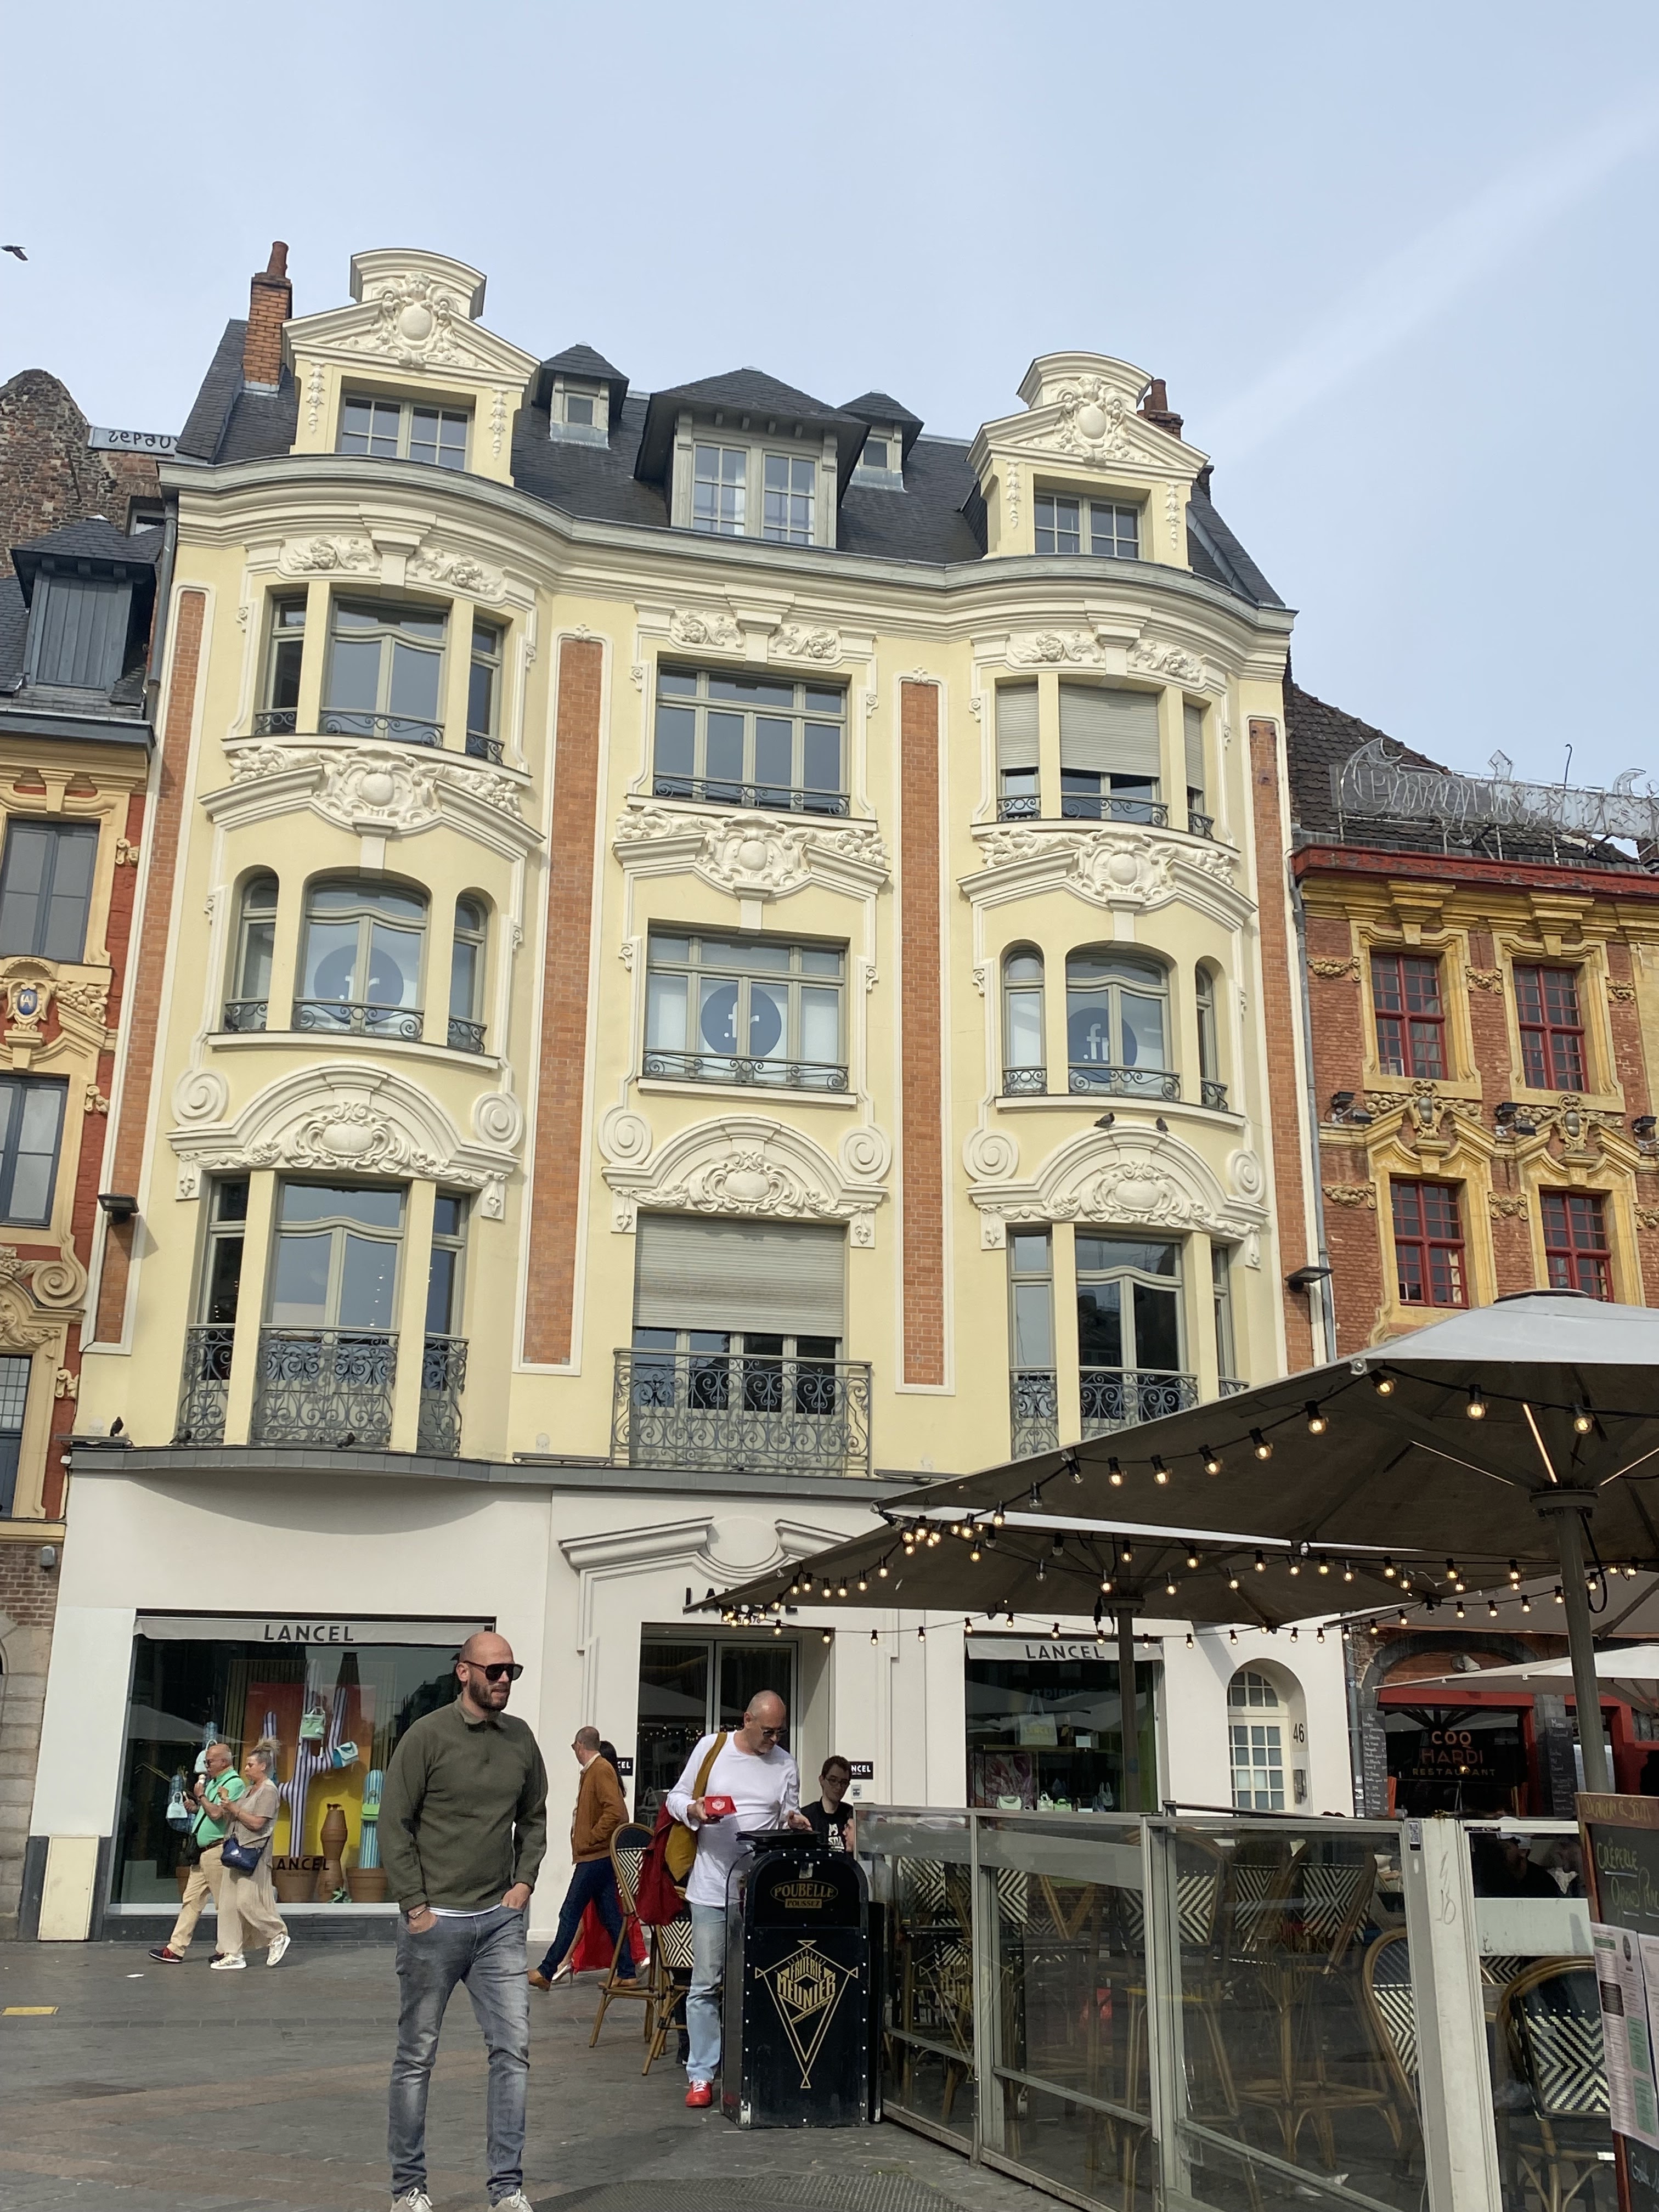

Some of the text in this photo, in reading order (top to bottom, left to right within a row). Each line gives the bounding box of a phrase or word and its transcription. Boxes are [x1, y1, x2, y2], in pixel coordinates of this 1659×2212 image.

[264, 1624, 354, 1642] LANCEL
[1025, 1645, 1105, 1660] LANCEL
[1293, 1723, 1305, 1743] 46
[1432, 1731, 1473, 1749] COQ
[1421, 1750, 1483, 1764] HARDI
[851, 1764, 871, 1773] NCEL
[276, 1858, 330, 1870] ANCEL
[774, 1883, 834, 1898] POUBELLE
[791, 1956, 822, 1981] FRITERIE
[777, 1972, 836, 2010] MEUNIER
